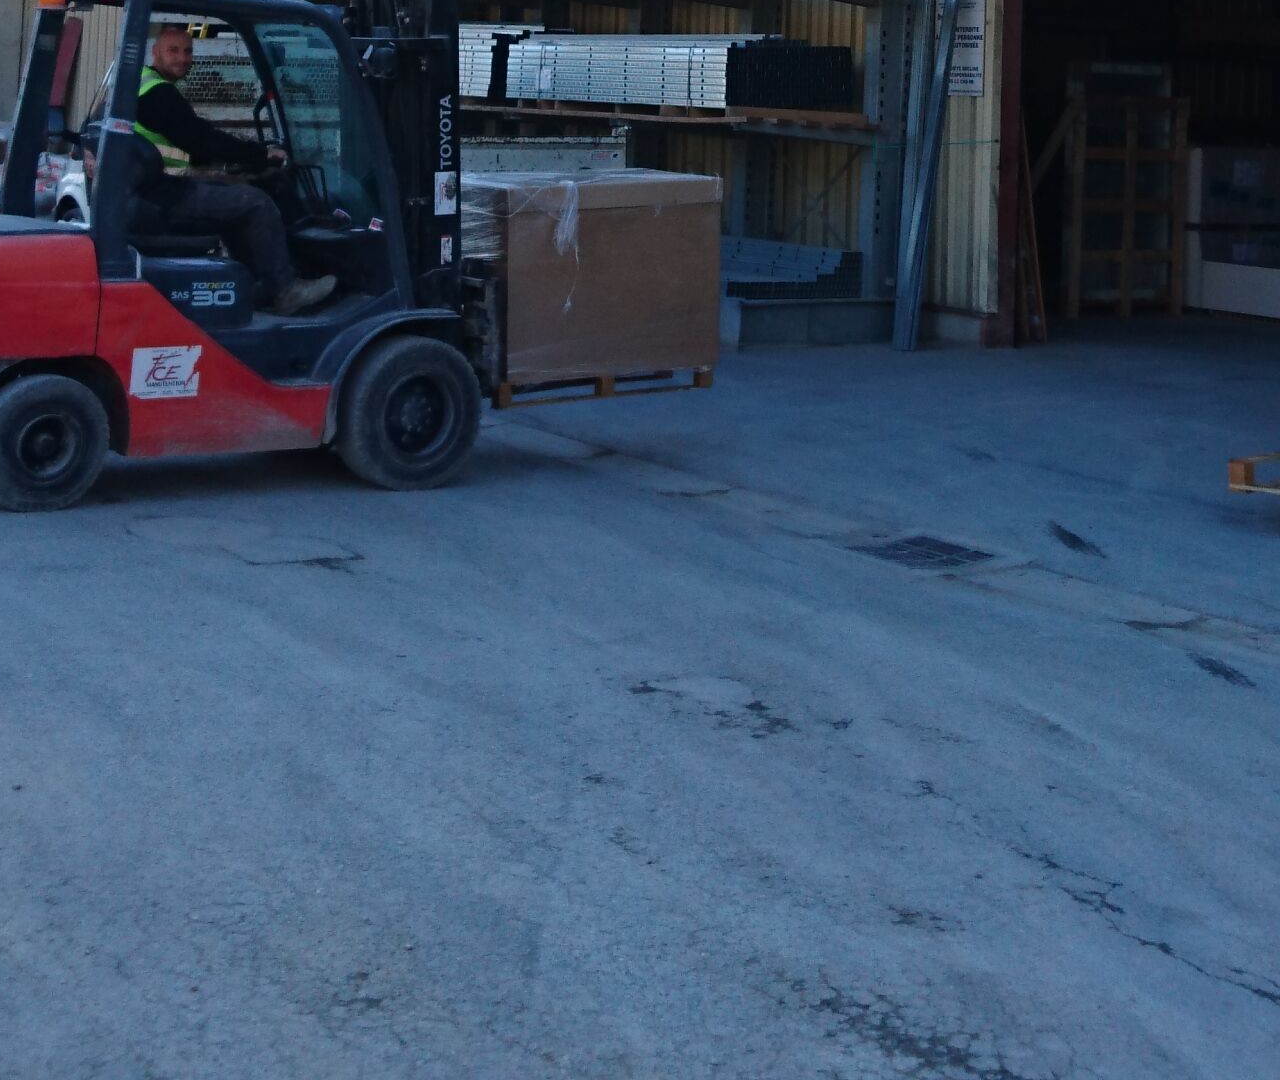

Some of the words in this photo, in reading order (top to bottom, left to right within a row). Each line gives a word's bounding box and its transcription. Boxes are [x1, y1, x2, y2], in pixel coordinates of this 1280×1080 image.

[439, 94, 452, 170] TOYOTA
[171, 291, 190, 299] SAS
[191, 290, 236, 306] 30
